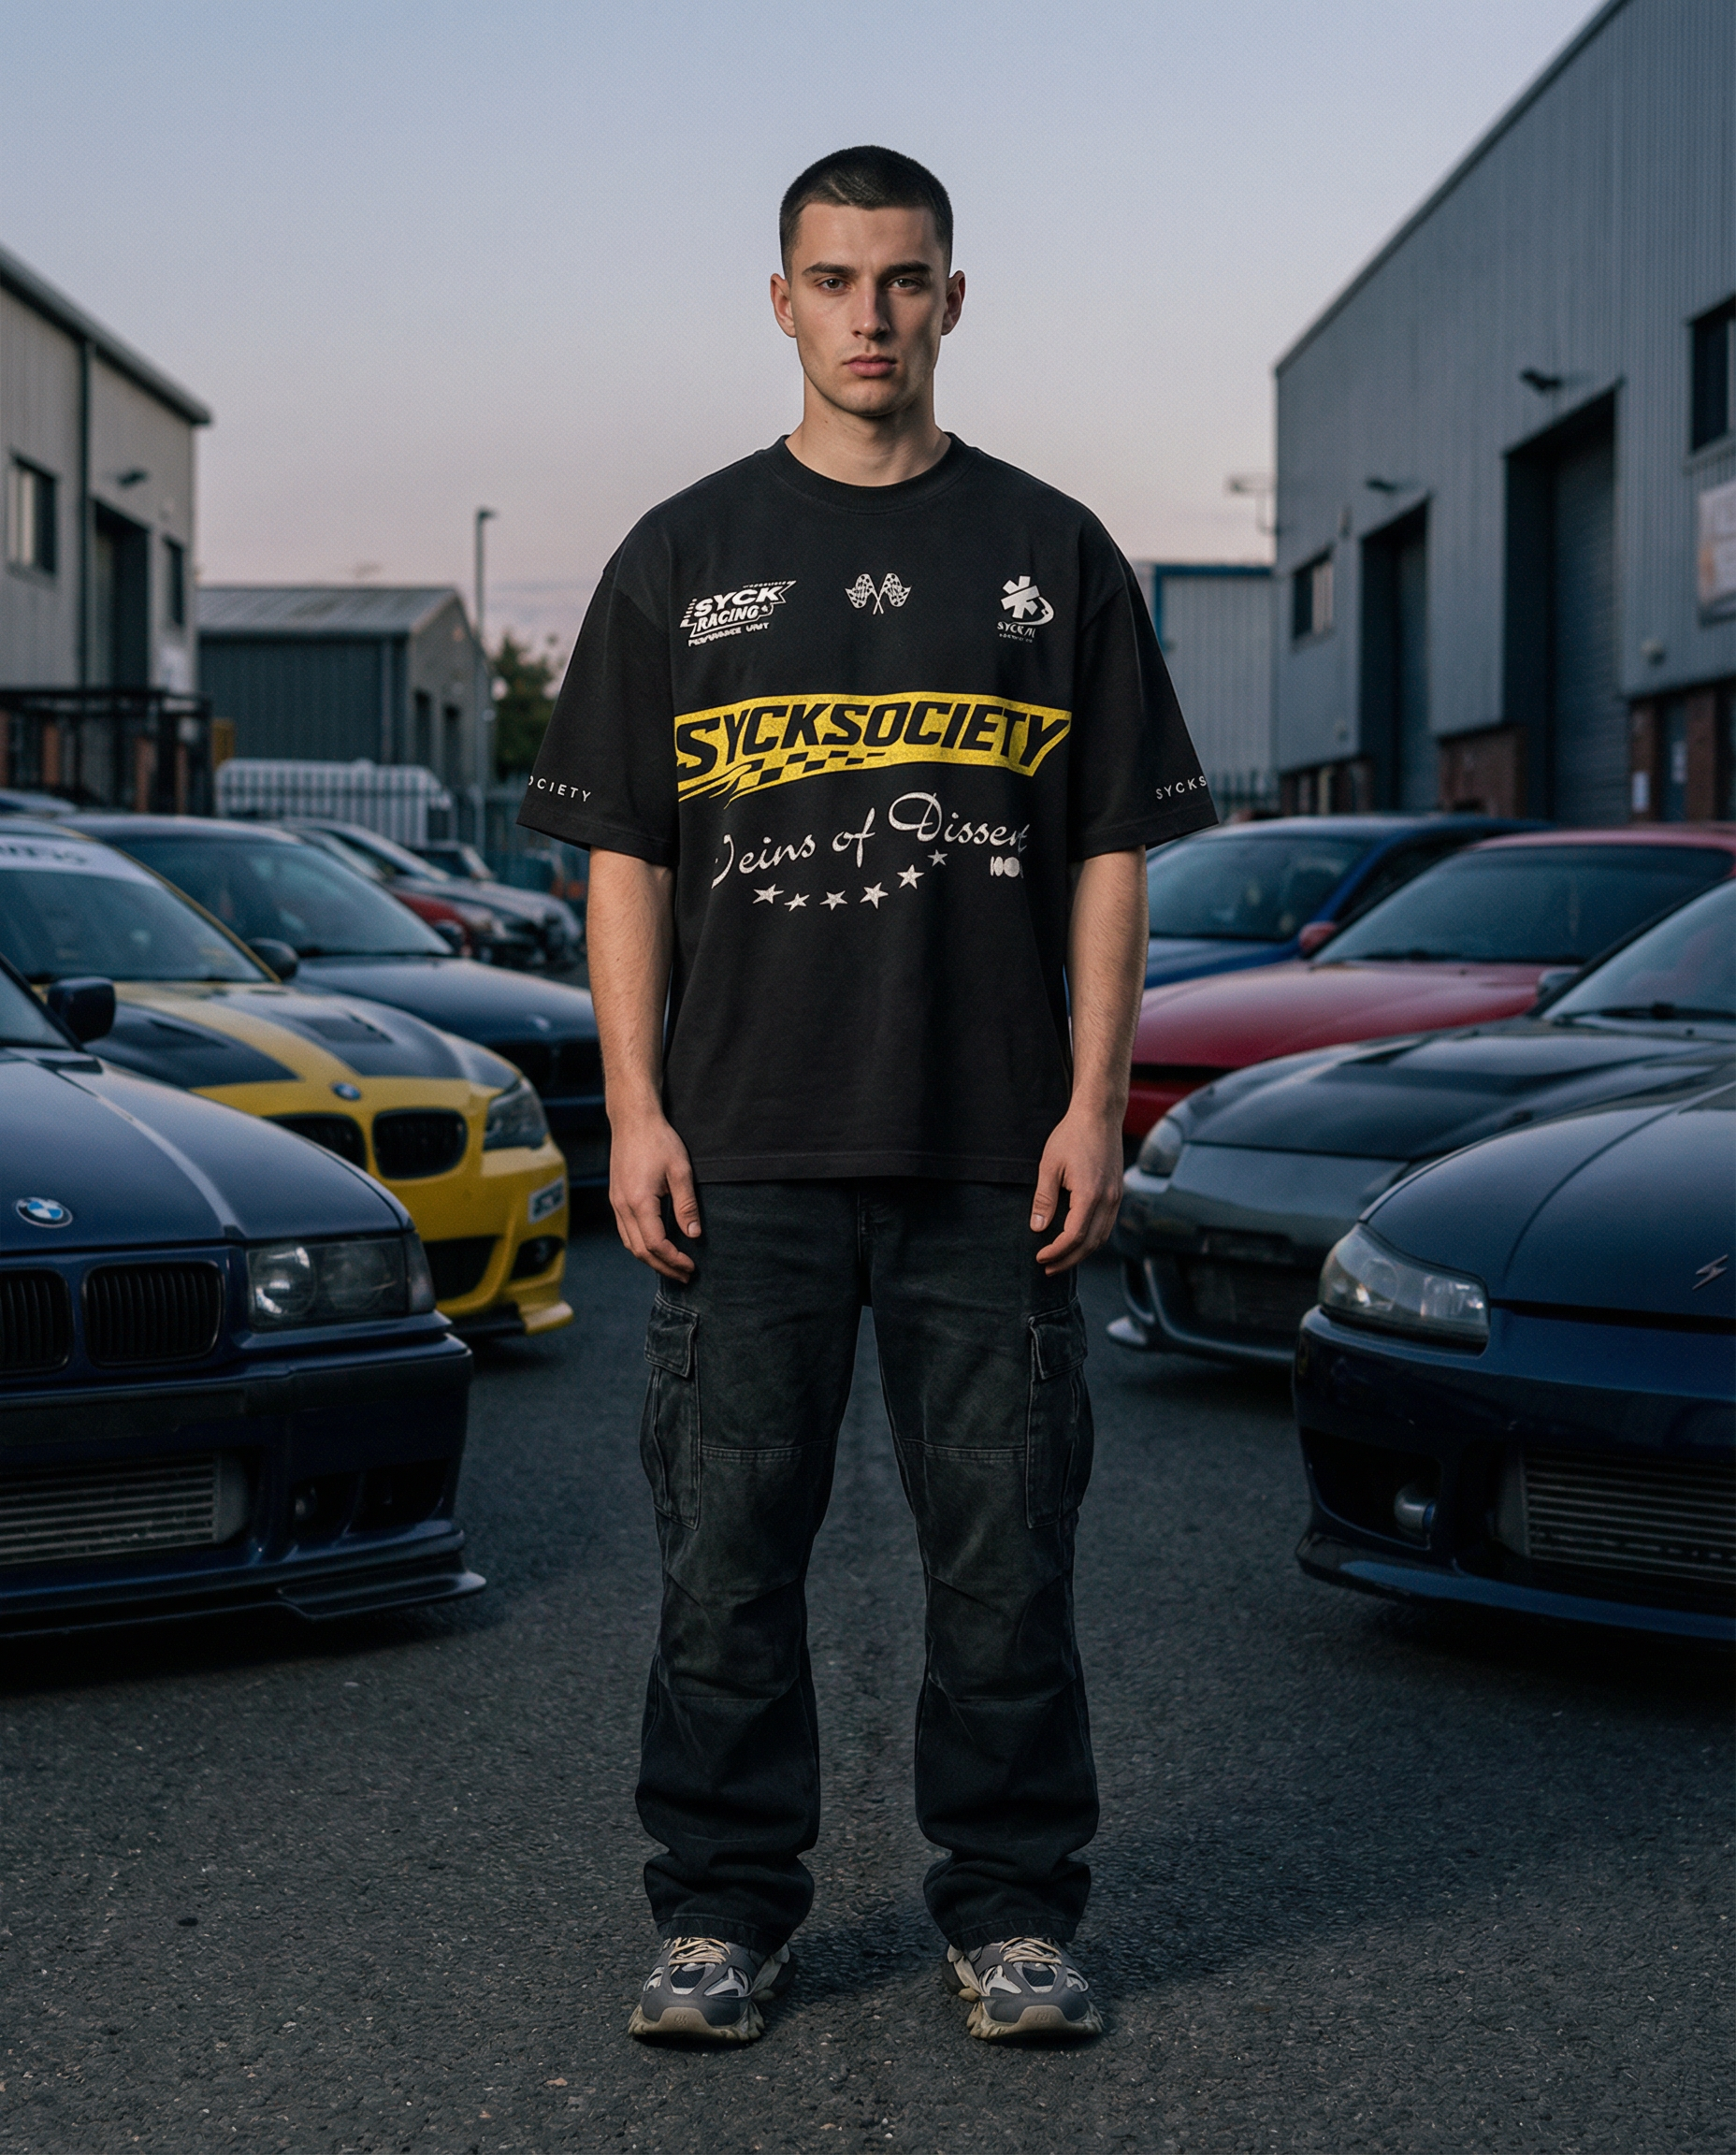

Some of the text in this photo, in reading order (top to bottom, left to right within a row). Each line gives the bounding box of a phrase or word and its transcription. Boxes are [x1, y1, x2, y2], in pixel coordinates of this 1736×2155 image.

[693, 586, 784, 617] SYCK
[696, 604, 760, 632] RACING
[676, 701, 1069, 782] SYCKSOCIETY
[1155, 775, 1208, 800] SYCKS
[832, 807, 876, 868] of
